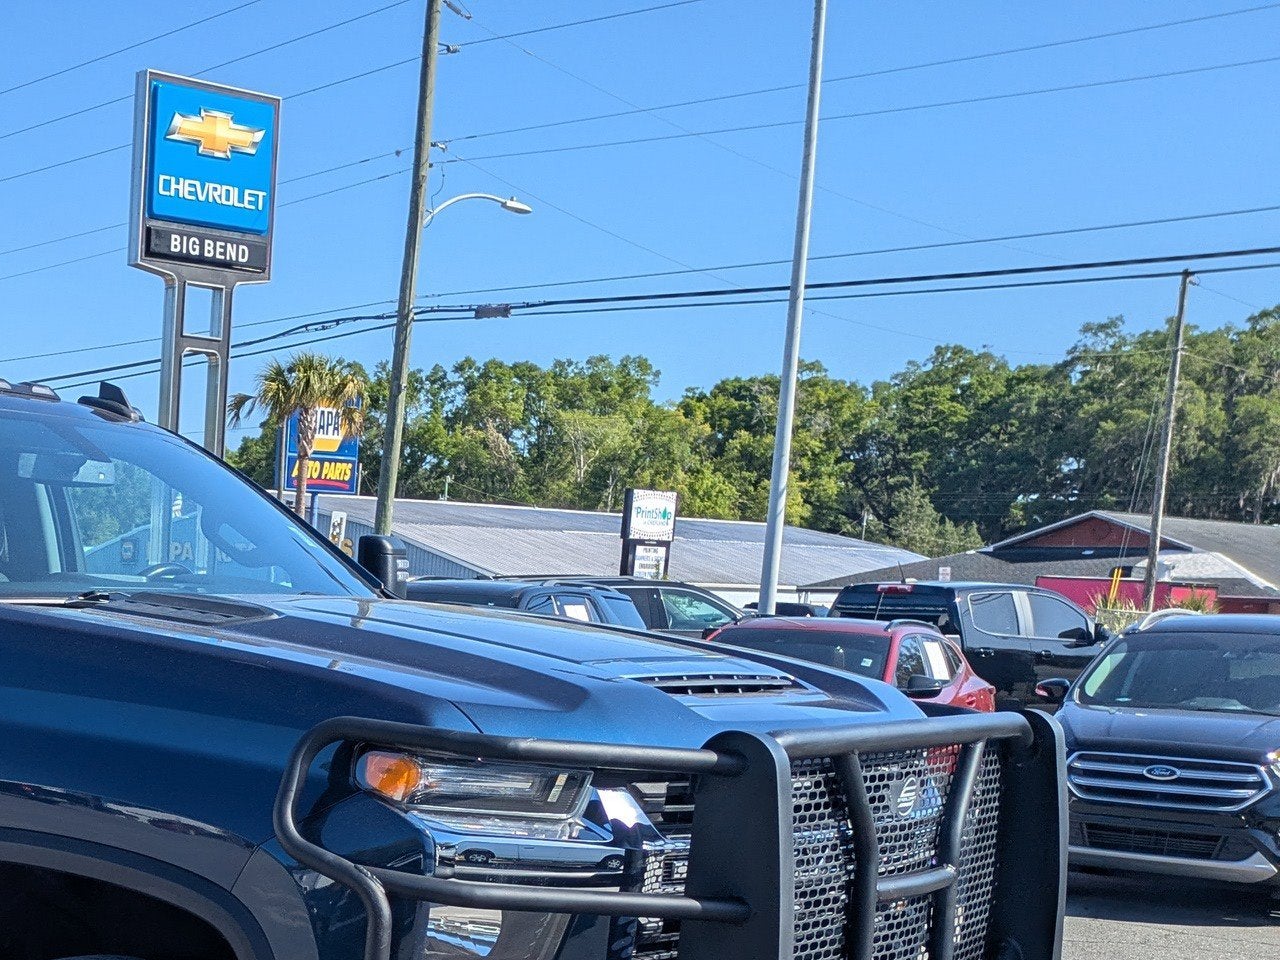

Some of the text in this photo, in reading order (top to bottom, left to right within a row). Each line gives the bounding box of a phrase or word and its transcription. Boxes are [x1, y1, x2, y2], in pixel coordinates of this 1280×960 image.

[158, 174, 267, 211] CHEVROLET
[170, 233, 249, 263] BIG BEND
[315, 409, 341, 436] APA
[291, 460, 353, 480] ATO PARTS
